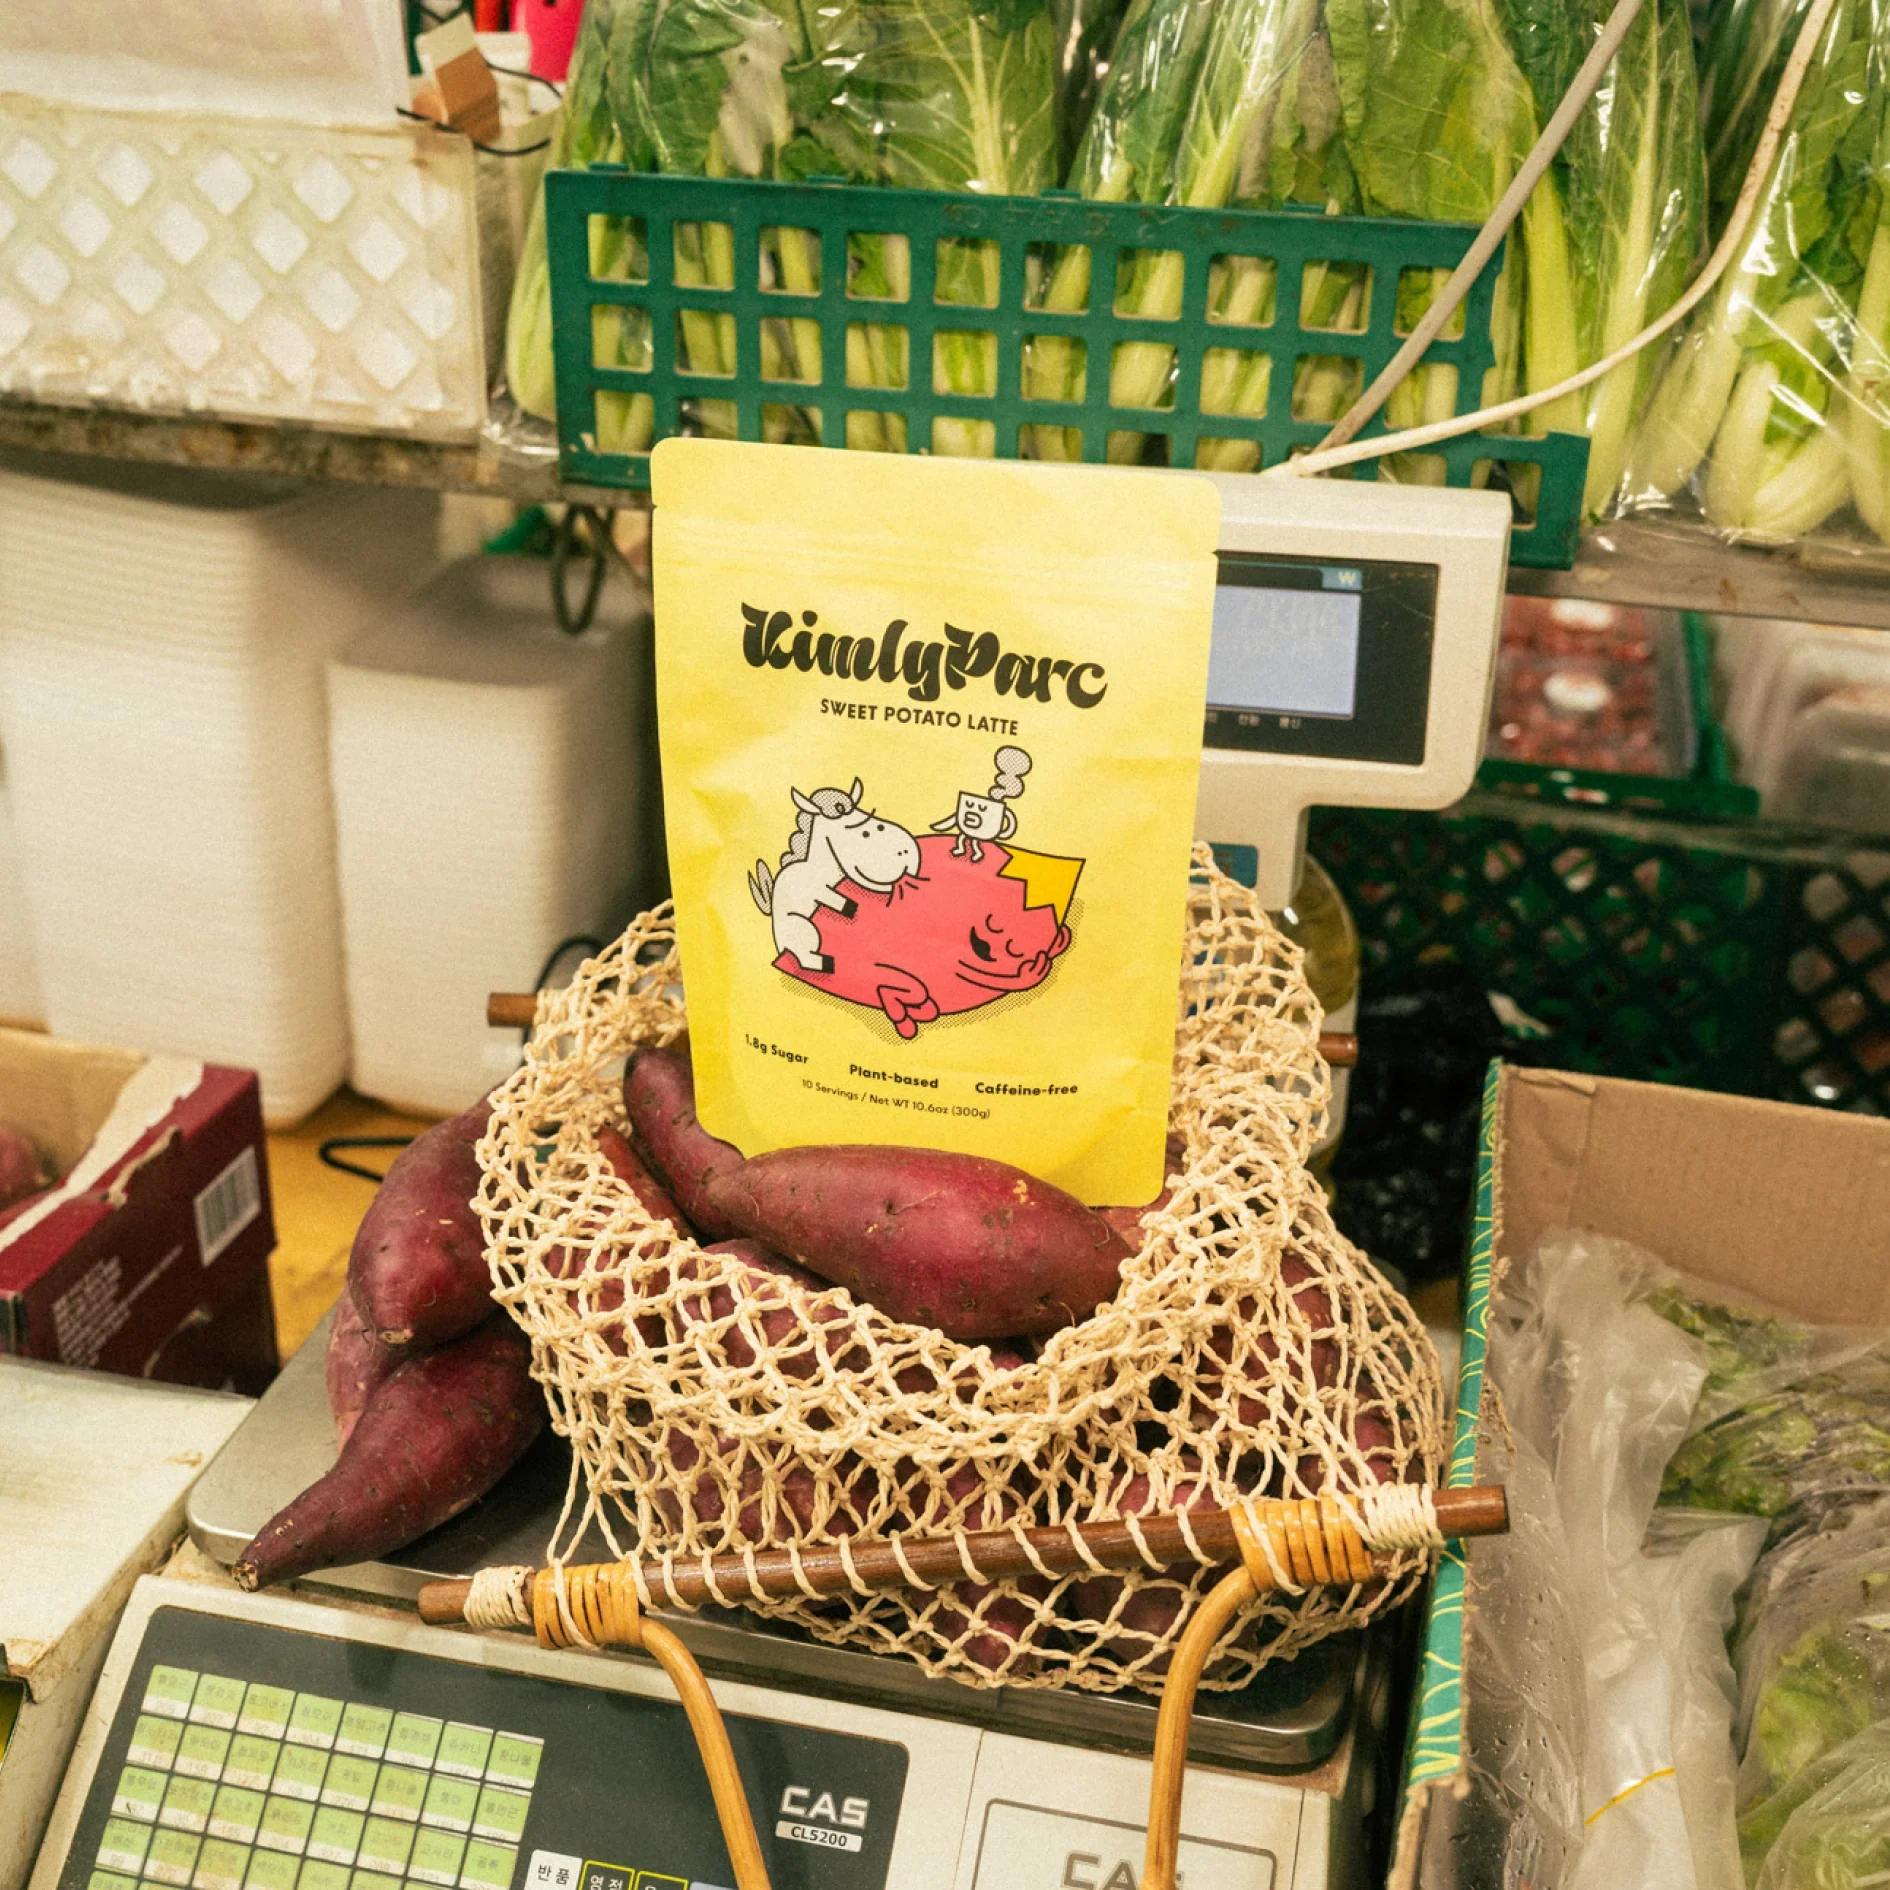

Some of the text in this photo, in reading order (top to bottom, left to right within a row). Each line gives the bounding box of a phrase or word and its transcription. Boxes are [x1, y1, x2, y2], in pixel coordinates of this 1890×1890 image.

[820, 698, 1019, 736] SWEET POTATO LATTE
[745, 1033, 809, 1064] 1.8g Sugar
[849, 1064, 940, 1089] Plant-based
[974, 1081, 1078, 1096] Caffeine-free
[802, 1078, 813, 1089] 10
[815, 1081, 859, 1101] Servings
[869, 1093, 889, 1106] Net
[892, 1097, 910, 1109] WT
[912, 1100, 949, 1115] 10.6oz
[951, 1105, 991, 1120] (300g)
[779, 1785, 870, 1829] CAS
[790, 1826, 848, 1847] CL5200
[537, 1863, 570, 1886] 반품
